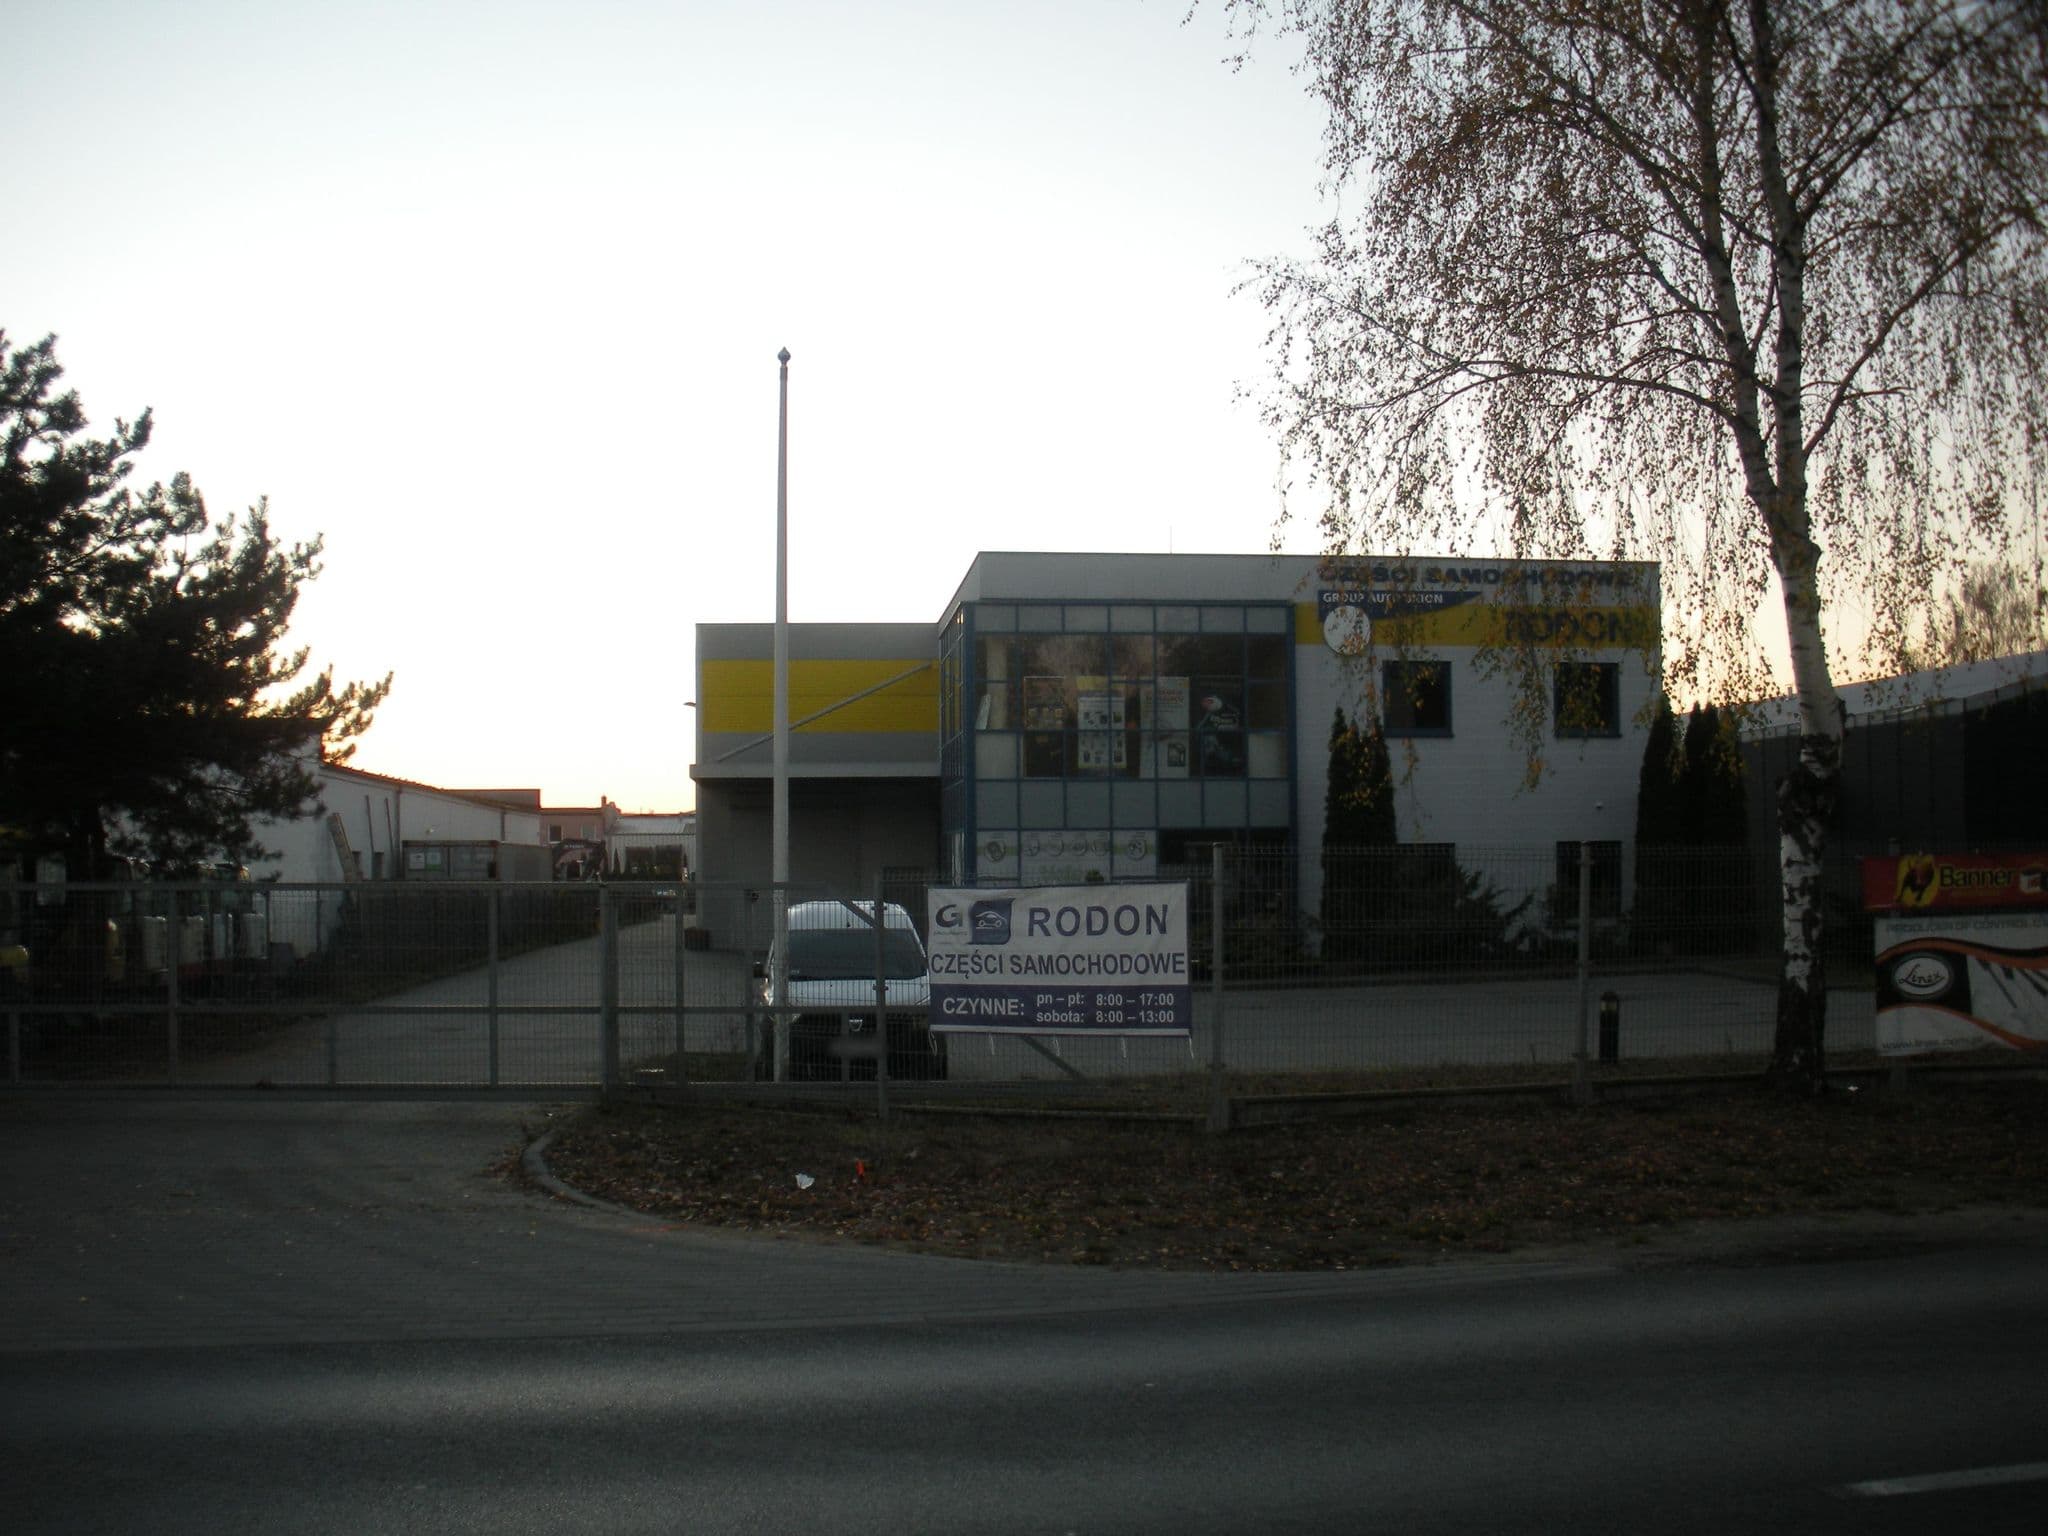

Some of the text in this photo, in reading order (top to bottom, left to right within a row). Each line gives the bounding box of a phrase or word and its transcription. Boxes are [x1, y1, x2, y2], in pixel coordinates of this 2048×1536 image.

[1322, 592, 1365, 604] GROUP
[1367, 592, 1398, 604] AUT
[1940, 865, 2016, 888] Banner
[1027, 903, 1169, 937] RODON
[930, 949, 1186, 979] CZĘŚCI SAMOCHODOWE
[942, 998, 1025, 1017] CZYNNE:
[1036, 994, 1053, 1007] pn
[1068, 993, 1085, 1007] pt:
[1096, 993, 1123, 1006] 8:00
[1139, 993, 1174, 1006] 17:00
[1036, 1009, 1085, 1024] sobota:
[1096, 1010, 1123, 1023] 8:00
[1139, 1010, 1174, 1023] 13:00
